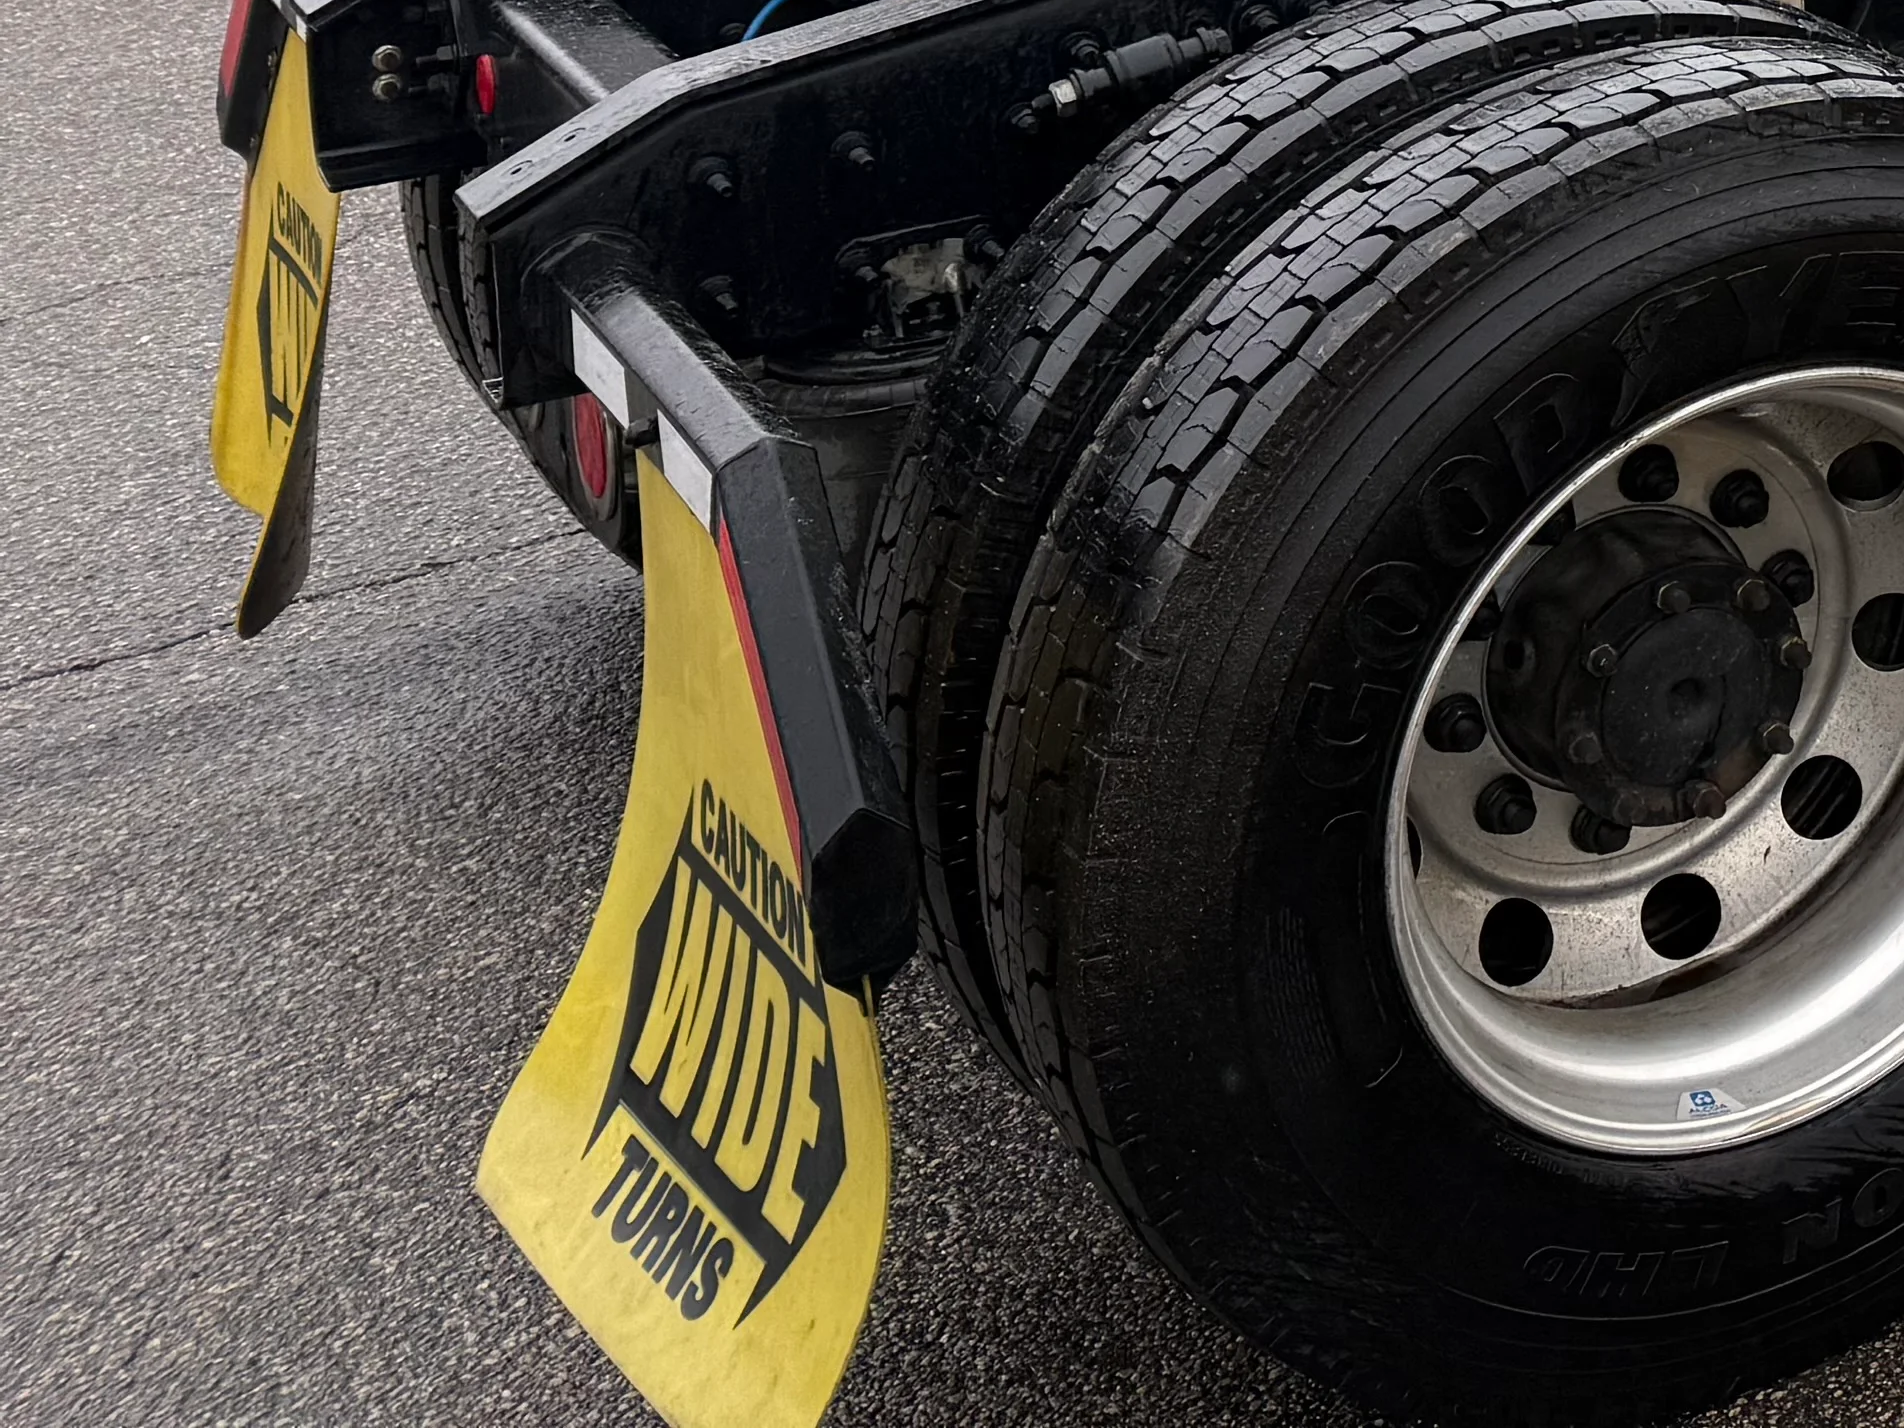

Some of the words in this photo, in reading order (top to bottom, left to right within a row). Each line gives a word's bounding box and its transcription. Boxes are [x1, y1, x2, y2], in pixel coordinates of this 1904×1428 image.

[276, 180, 323, 290] CAUTION
[699, 778, 807, 960] CAUTION
[630, 869, 828, 1246] WIDE
[590, 1135, 737, 1322] TURNS
